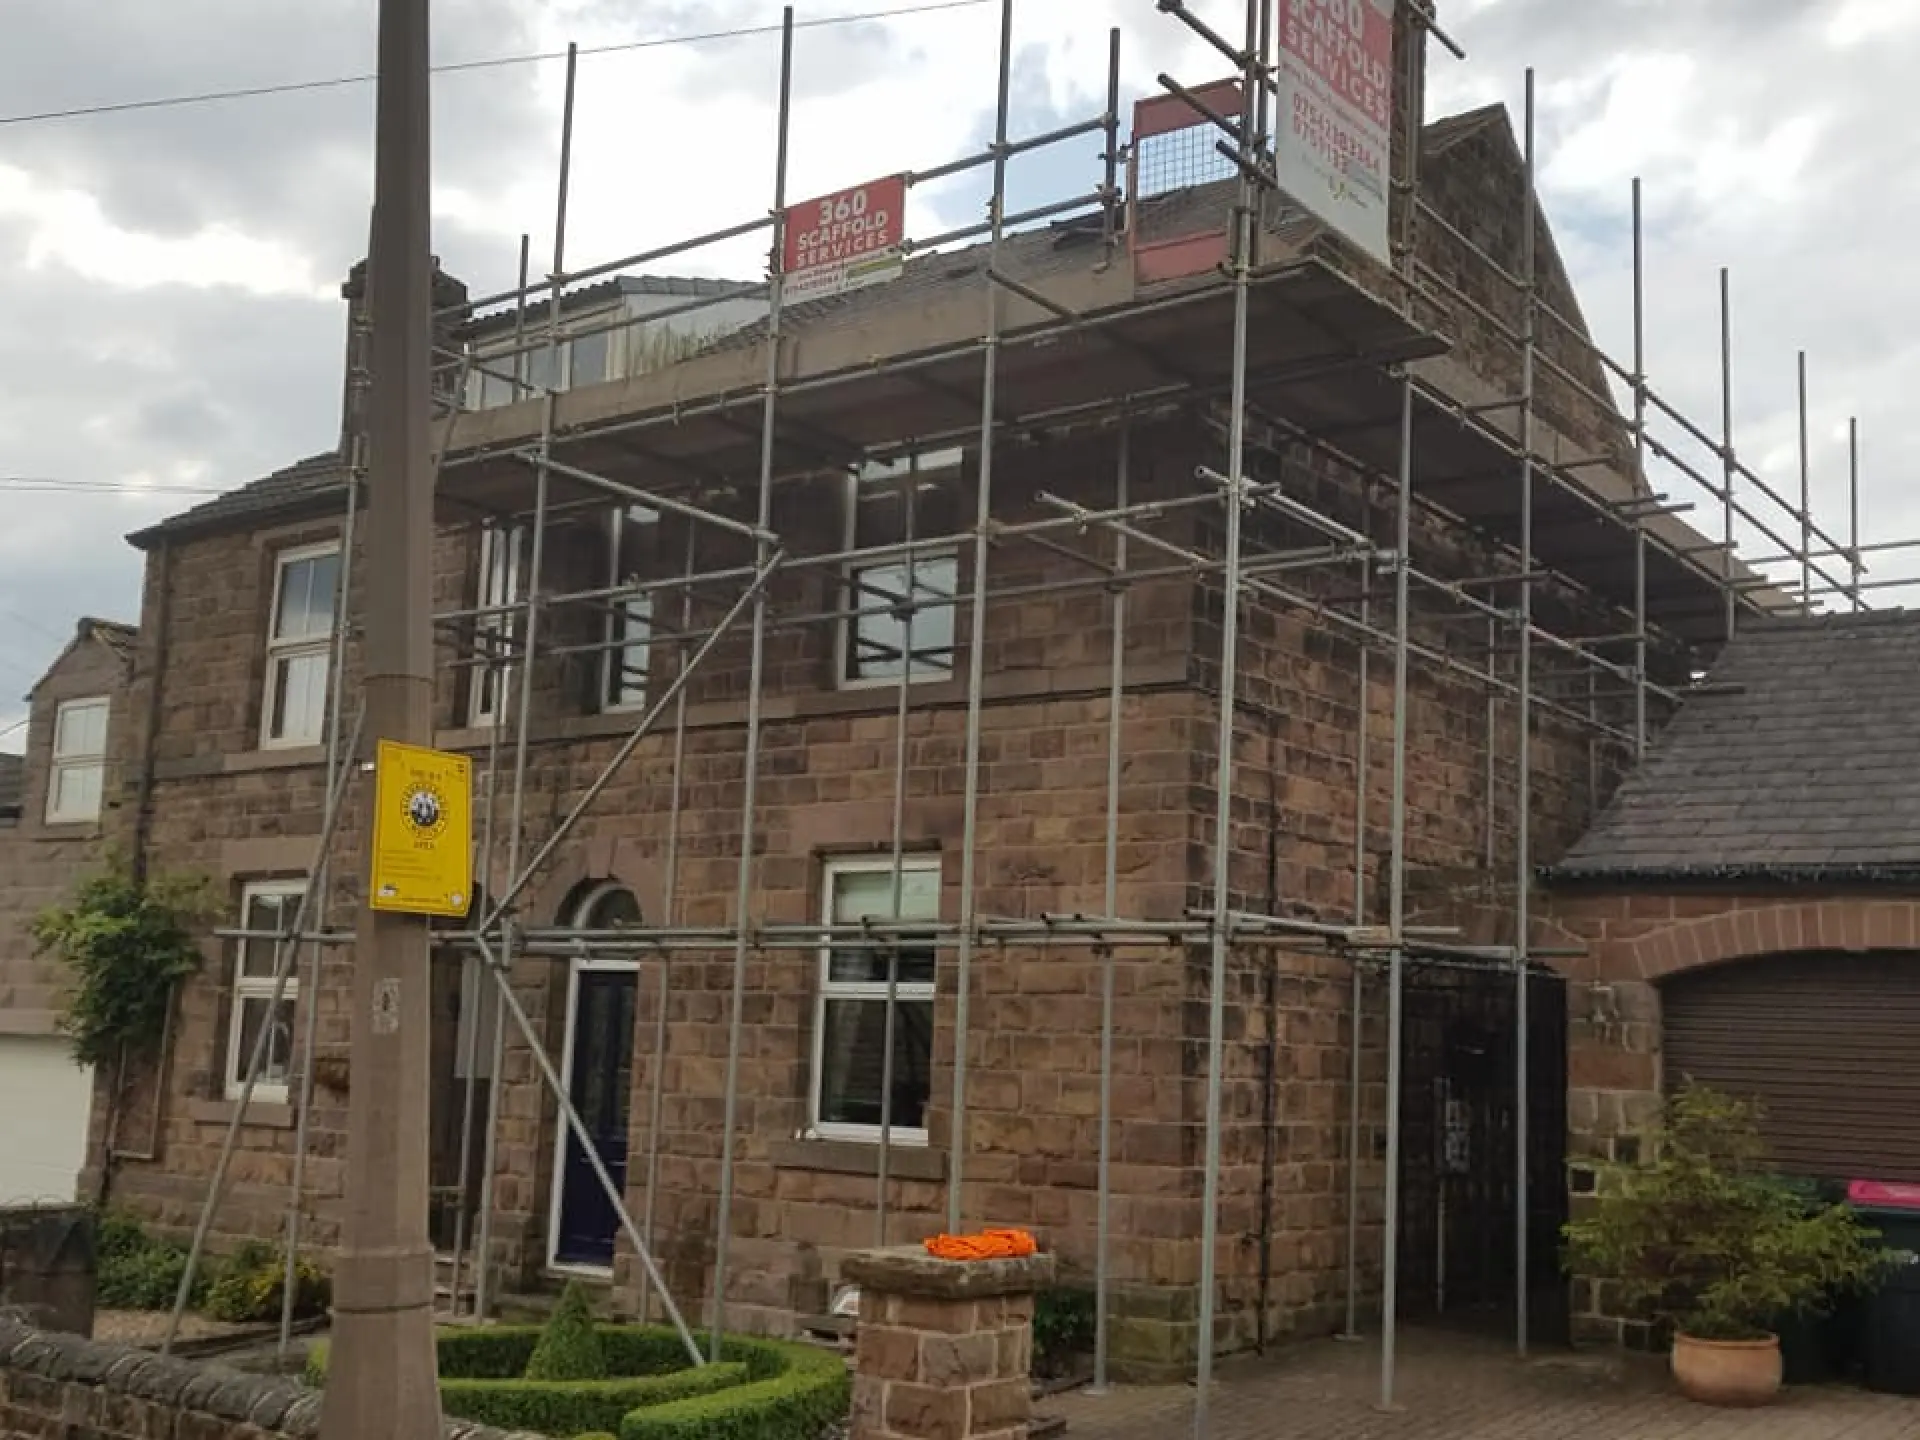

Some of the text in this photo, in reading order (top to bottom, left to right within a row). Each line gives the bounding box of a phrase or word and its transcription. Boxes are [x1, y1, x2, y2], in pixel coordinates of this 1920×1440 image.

[1286, 18, 1385, 121] SERVICES
[818, 189, 867, 225] 360
[796, 229, 889, 269] SERVICES
[798, 210, 889, 251] SCAFFOLD
